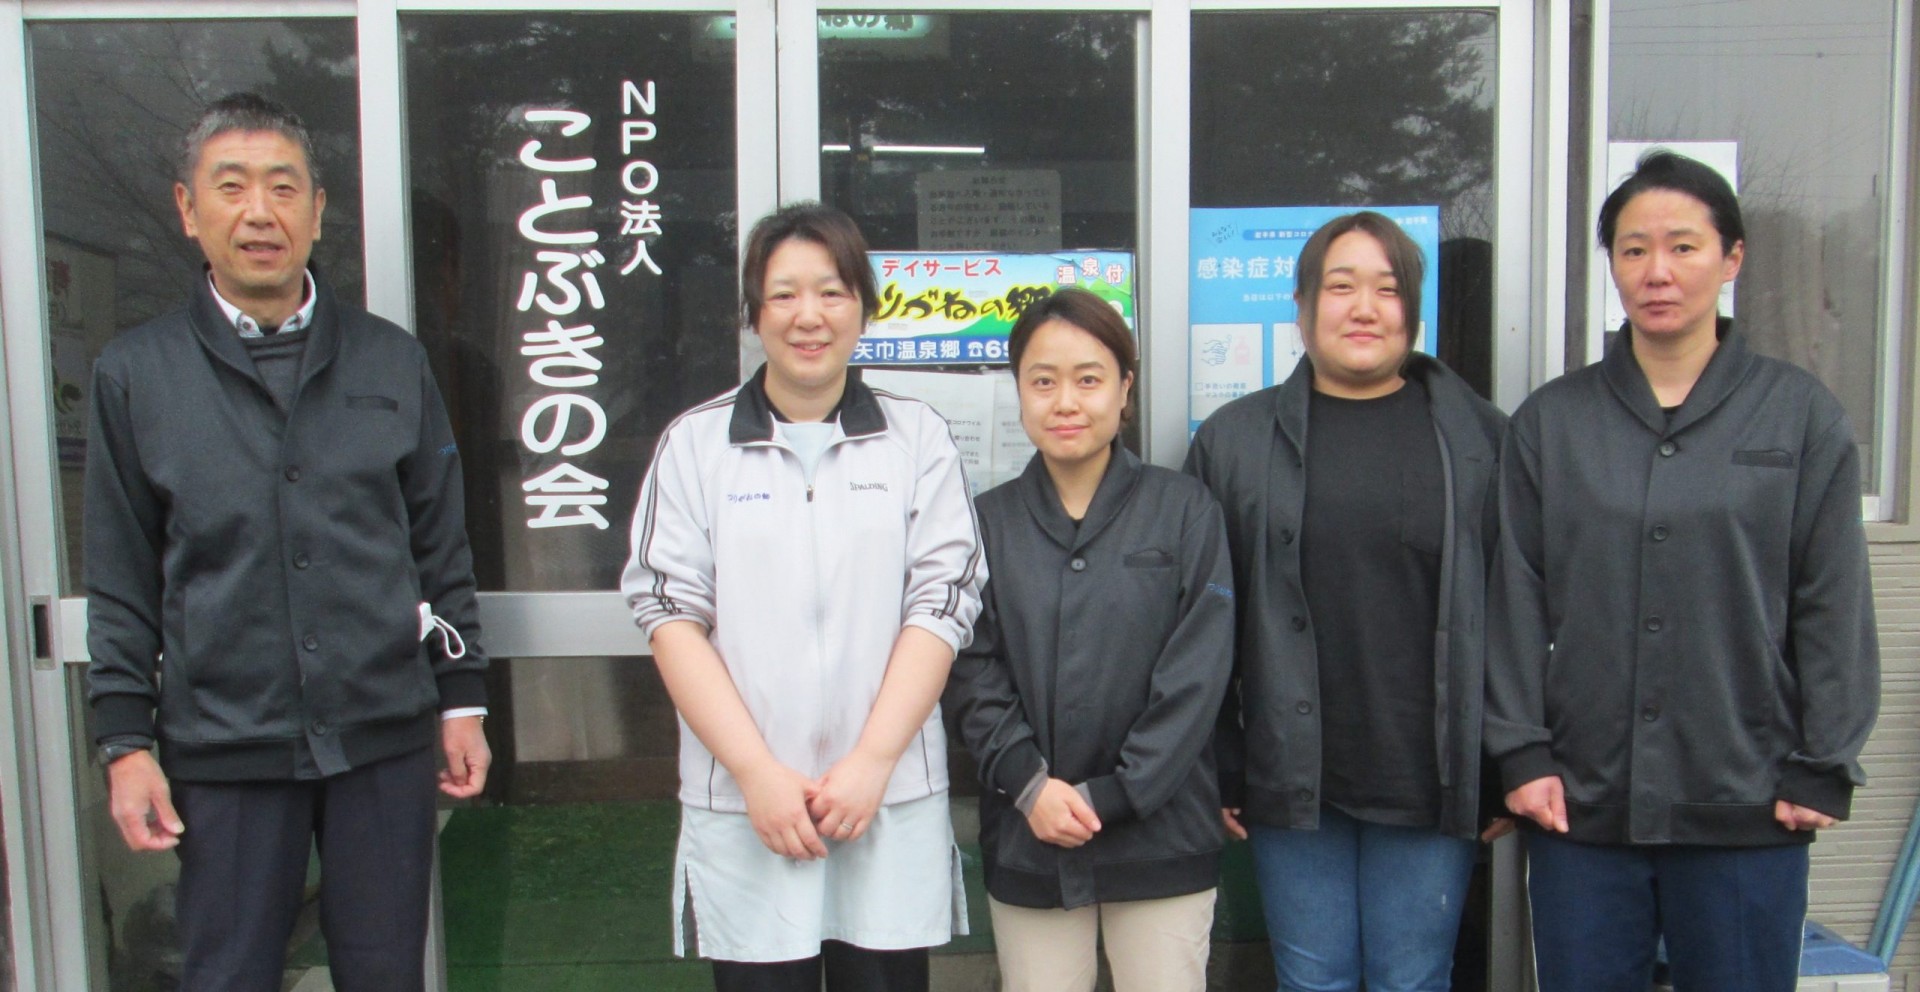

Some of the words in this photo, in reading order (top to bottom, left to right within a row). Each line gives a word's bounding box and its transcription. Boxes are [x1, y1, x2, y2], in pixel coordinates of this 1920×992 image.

[620, 80, 663, 275] NPO法人
[882, 258, 1002, 277] デイサービス
[1056, 257, 1125, 285] 温泉付
[1197, 256, 1295, 279] 感染症対
[517, 110, 609, 530] ことぶきの会
[855, 339, 961, 360] 矢巾温泉郷
[849, 481, 889, 492] SPALDING
